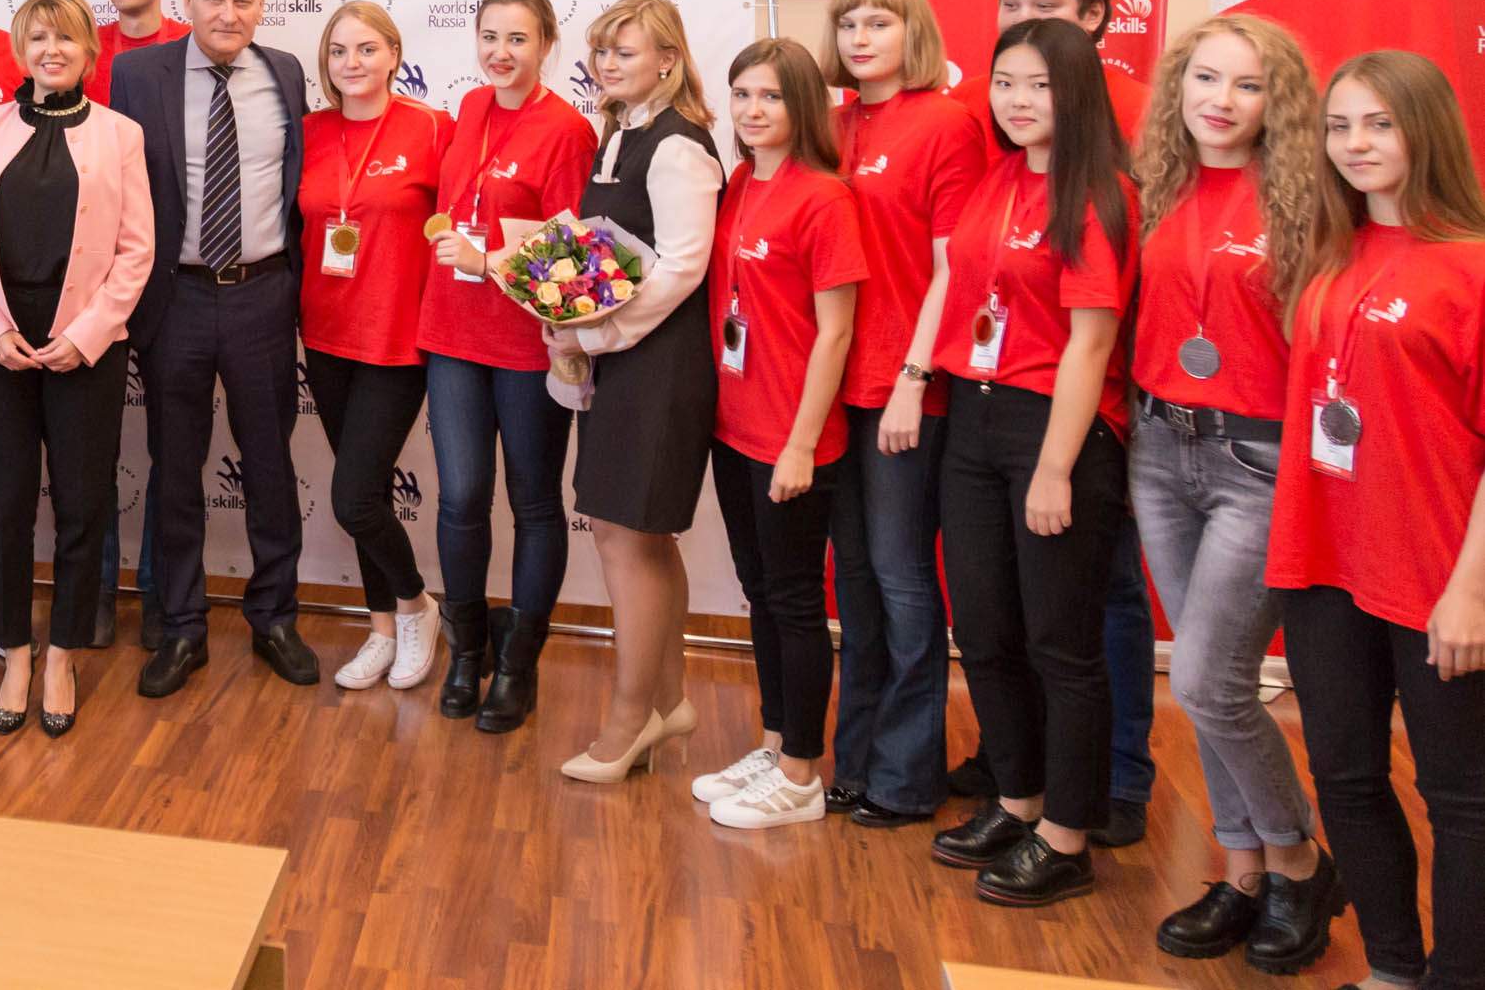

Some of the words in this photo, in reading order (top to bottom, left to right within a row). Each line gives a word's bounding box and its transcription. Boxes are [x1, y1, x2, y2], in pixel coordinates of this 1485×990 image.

[258, 16, 286, 27] ussia
[429, 15, 466, 27] Russia
[1107, 17, 1148, 34] skills
